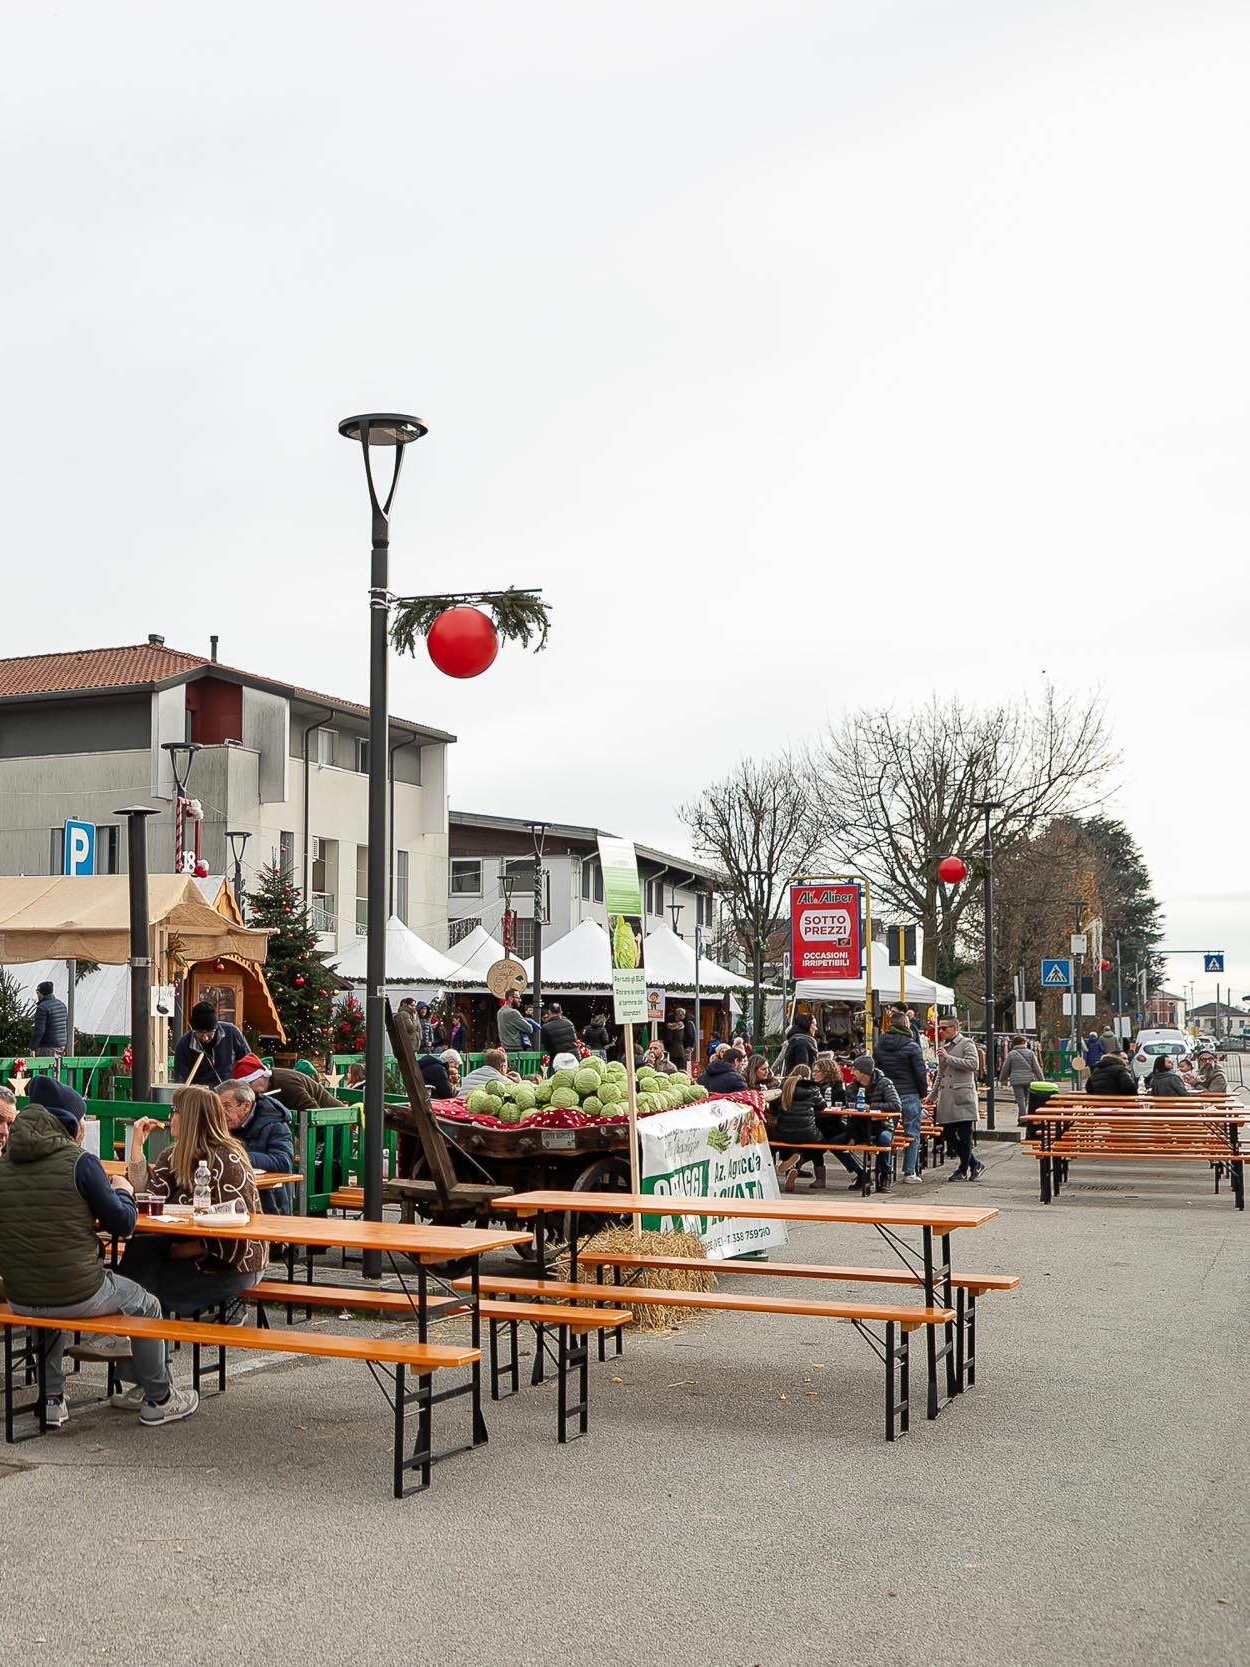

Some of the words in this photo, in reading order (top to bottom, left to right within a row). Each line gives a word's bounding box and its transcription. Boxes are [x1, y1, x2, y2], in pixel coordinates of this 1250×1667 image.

[70, 827, 90, 876] P
[181, 850, 196, 874] 18
[804, 915, 847, 926] SOTTO
[804, 925, 847, 936] PREZZI
[803, 951, 848, 960] OCCASIONI
[802, 959, 850, 967] IRRIPETIBILI
[714, 1162, 726, 1183] Az.
